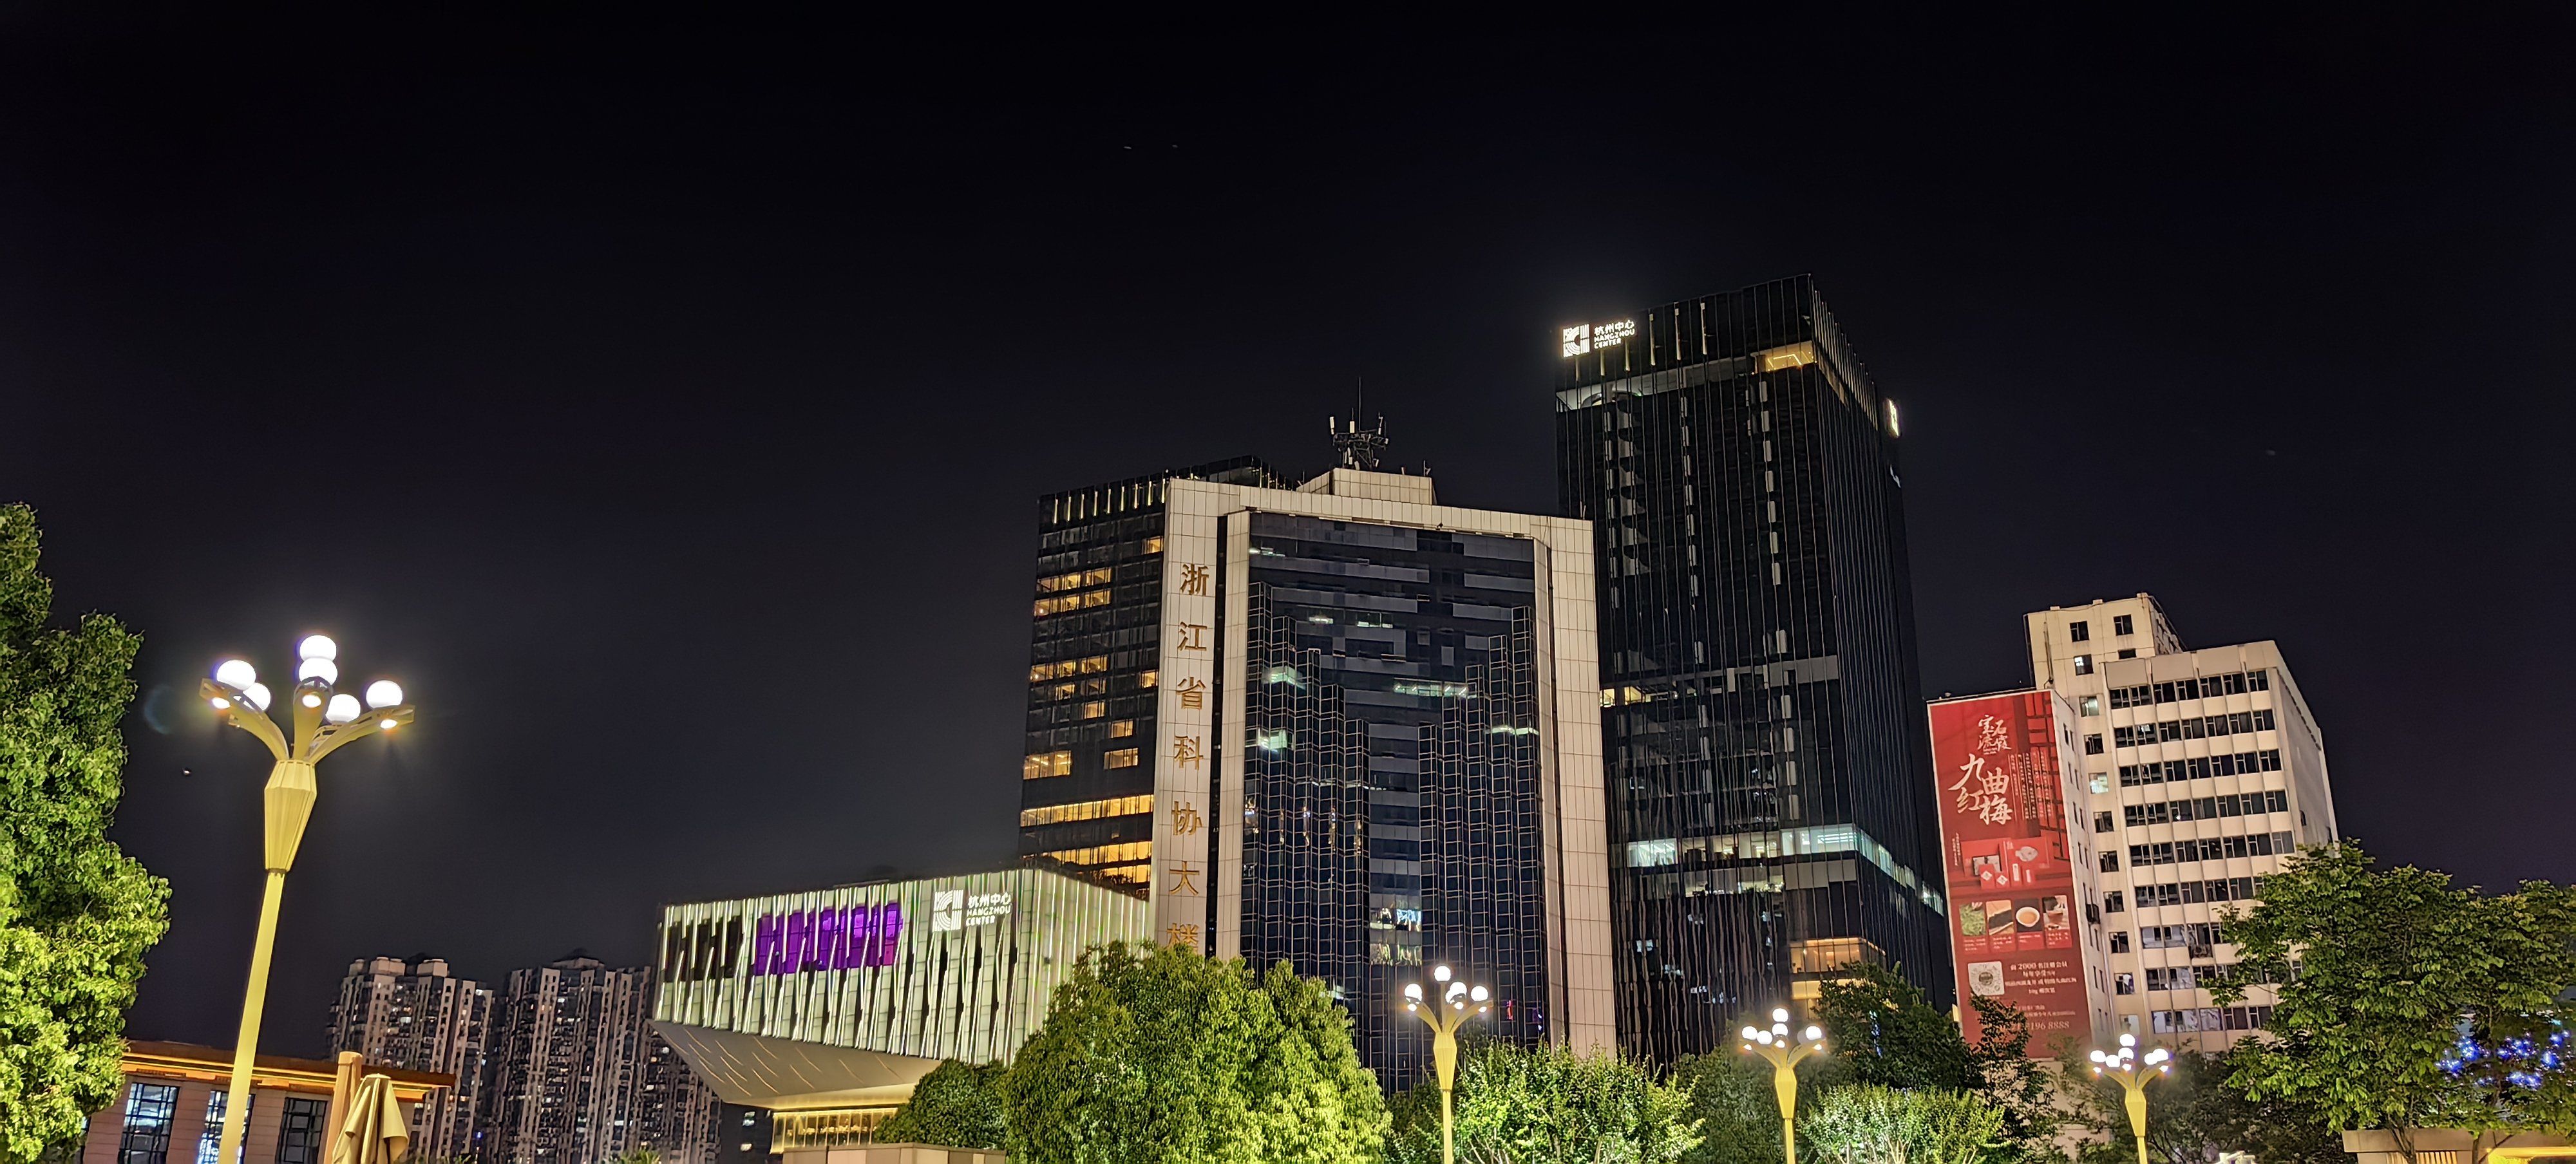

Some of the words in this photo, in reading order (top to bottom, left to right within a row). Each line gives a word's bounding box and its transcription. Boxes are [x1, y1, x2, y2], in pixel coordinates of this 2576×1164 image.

[1594, 319, 1634, 336] 杭州中心
[1594, 328, 1635, 343] HANGZHOU
[1594, 337, 1622, 349] CENTER
[1165, 563, 1210, 955] 浙江省科协大楼
[968, 892, 1011, 908] 杭州中心
[967, 905, 1010, 917] HANGZHOU
[965, 915, 995, 926] CENTER
